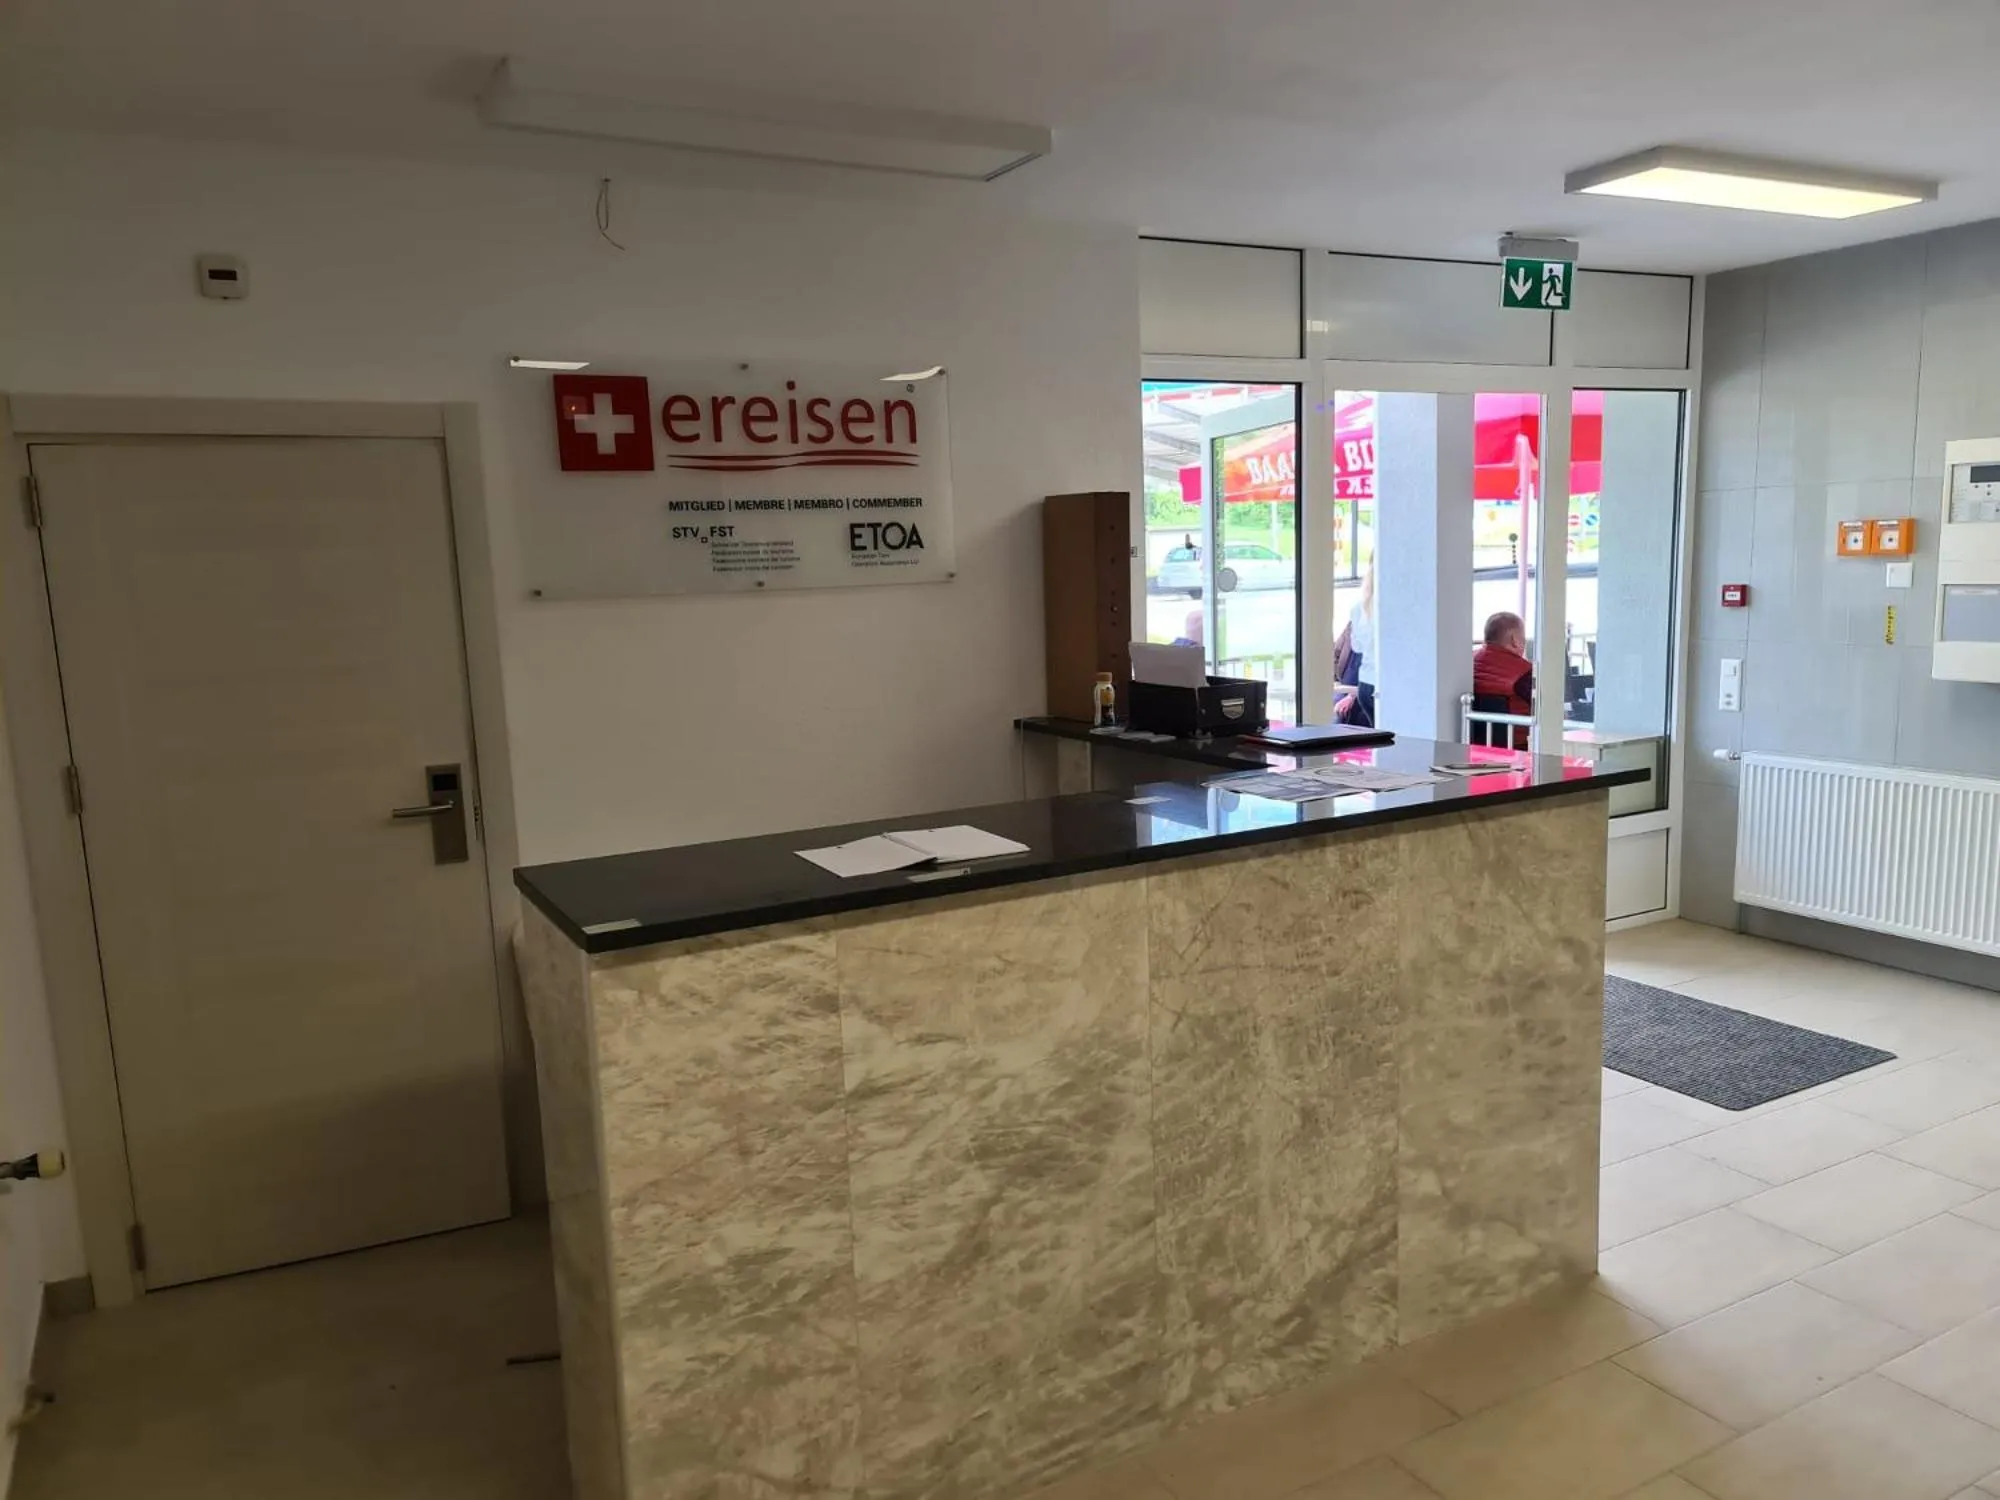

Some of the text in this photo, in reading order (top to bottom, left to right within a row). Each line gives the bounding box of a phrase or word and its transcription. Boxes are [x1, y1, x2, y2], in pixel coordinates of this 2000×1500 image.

[661, 380, 918, 445] ereisen
[668, 497, 923, 511] MITGLIED MEMBRE MEMBRO COMMEMBER
[672, 525, 735, 538] STV FST
[849, 522, 924, 551] ETOA
